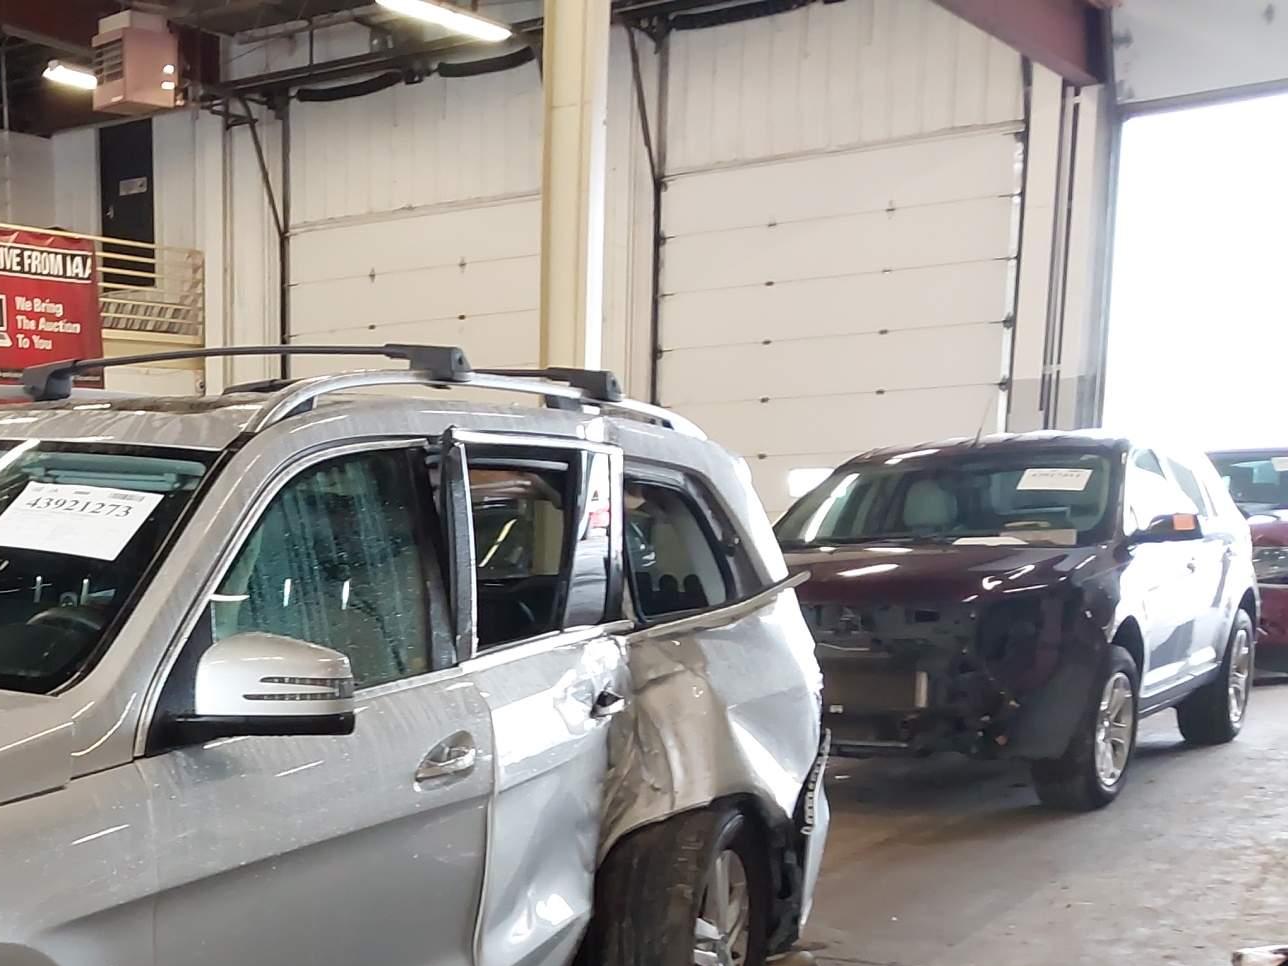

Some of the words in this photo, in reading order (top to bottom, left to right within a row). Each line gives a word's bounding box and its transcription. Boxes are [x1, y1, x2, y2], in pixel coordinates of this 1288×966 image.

[23, 251, 62, 277] FROM
[15, 296, 32, 311] We
[33, 298, 63, 317] Bring
[16, 315, 37, 331] The
[38, 317, 81, 334] Auction
[16, 334, 30, 349] To
[32, 335, 53, 350] You
[25, 497, 135, 518] 43921273
